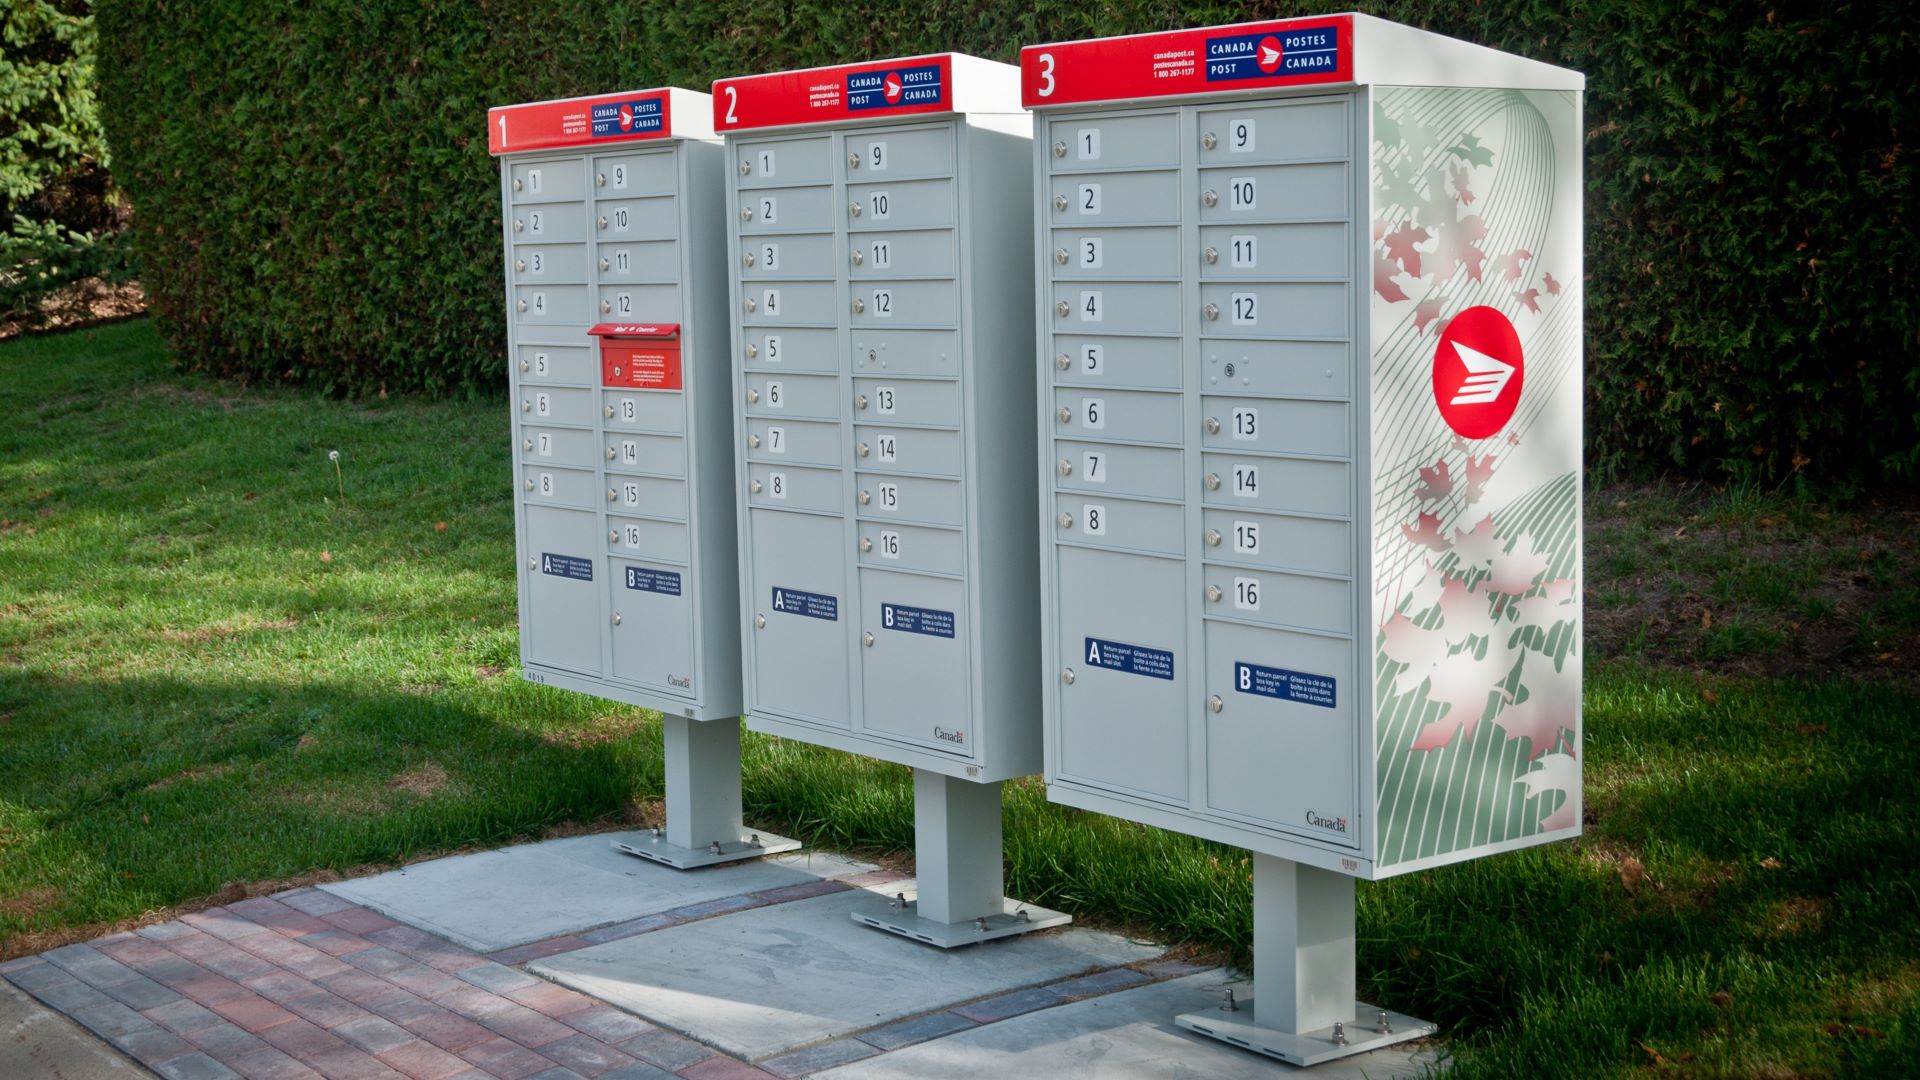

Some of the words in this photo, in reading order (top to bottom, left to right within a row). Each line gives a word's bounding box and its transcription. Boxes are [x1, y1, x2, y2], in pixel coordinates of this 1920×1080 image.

[1211, 41, 1254, 55] CANADA
[1286, 34, 1326, 47] POSTES
[1154, 50, 1194, 60] canadapost.ca
[1286, 56, 1331, 68] CANADA
[1154, 60, 1194, 70] postescanada.ca
[1159, 70, 1168, 78] 800
[1170, 68, 1194, 77] 267-1177
[1211, 63, 1237, 75] POST
[851, 77, 881, 87] CANADA
[904, 72, 933, 82] POSTES
[1038, 53, 1055, 97] 3
[851, 95, 870, 105] POST
[904, 89, 937, 100] CANADA
[594, 108, 618, 117] CANADA
[634, 104, 657, 113] POSTES
[725, 86, 738, 124] 2
[498, 115, 507, 147] 1
[594, 124, 609, 132] POST
[635, 119, 660, 129] CANADA
[1085, 133, 1092, 155] 1
[1236, 124, 1248, 147] 9
[763, 154, 769, 173] 1
[873, 146, 882, 166] 9
[532, 173, 537, 189] 1
[616, 167, 623, 185] 9
[1084, 188, 1095, 210] 2
[1233, 182, 1254, 205] 10
[764, 200, 772, 220] 2
[872, 195, 888, 215] 10
[533, 214, 539, 231] 2
[615, 210, 628, 228] 10
[766, 247, 774, 266] 3
[873, 244, 887, 264] 11
[1086, 242, 1096, 264] 3
[1233, 240, 1252, 263] 11
[534, 254, 541, 271] 3
[617, 253, 628, 270] 11
[536, 295, 543, 311] 4
[618, 295, 631, 313] 12
[767, 293, 776, 311] 4
[875, 293, 890, 313] 12
[1085, 295, 1097, 316] 4
[1234, 297, 1255, 320] 12
[769, 339, 777, 358] 5
[539, 356, 545, 372] 5
[1087, 349, 1097, 370] 5
[771, 385, 779, 403] 6
[878, 390, 894, 410] 13
[540, 396, 546, 412] 6
[622, 401, 634, 419] 13
[1088, 402, 1098, 424] 6
[1235, 412, 1256, 435] 13
[541, 436, 547, 451] 7
[772, 430, 780, 449] 7
[879, 439, 895, 458] 14
[623, 444, 636, 461] 14
[1089, 455, 1099, 477] 7
[543, 476, 550, 492] 8
[774, 476, 782, 495] 8
[1235, 469, 1257, 492] 14
[625, 485, 637, 503] 15
[881, 487, 896, 507] 15
[1089, 509, 1099, 530] 8
[626, 527, 639, 545] 16
[882, 535, 898, 555] 16
[1236, 526, 1257, 549] 15
[544, 555, 552, 573] A
[628, 569, 635, 586] B
[775, 590, 784, 609] A
[1237, 582, 1258, 605] 16
[885, 606, 894, 626] B
[1088, 641, 1101, 664] A
[1134, 650, 1147, 658] Glissez
[668, 674, 689, 688] Canada
[1240, 666, 1251, 689] B
[1256, 670, 1272, 678] Return
[1290, 676, 1306, 684] Glissez
[1296, 691, 1309, 699] fente
[1307, 686, 1318, 694] colis
[1319, 688, 1331, 696] dans
[934, 727, 963, 744] Canada
[1306, 810, 1346, 833] Canada
